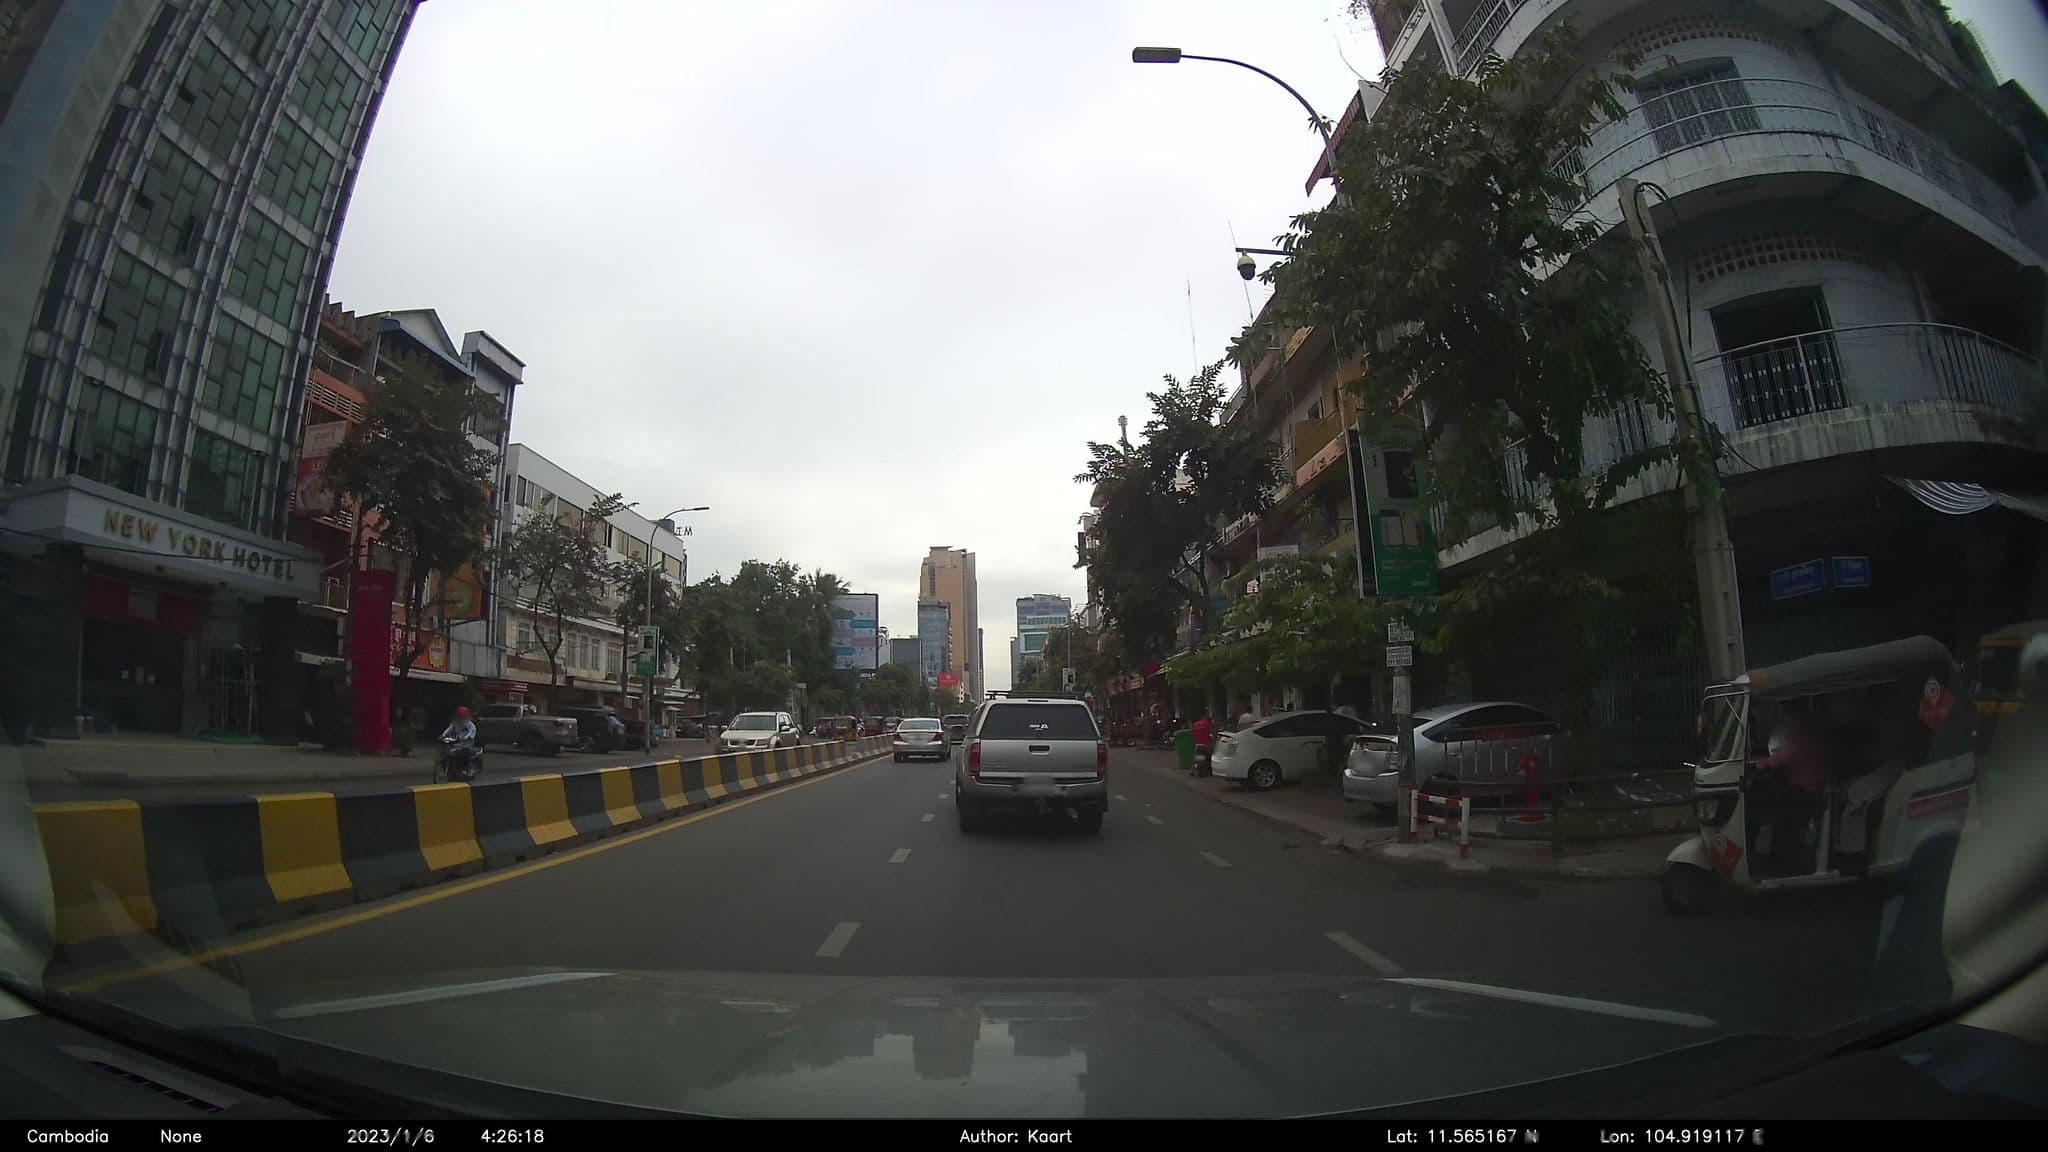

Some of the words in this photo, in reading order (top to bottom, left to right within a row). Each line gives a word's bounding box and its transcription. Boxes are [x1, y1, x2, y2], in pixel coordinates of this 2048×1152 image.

[105, 510, 157, 543] NEW
[169, 528, 225, 560] YORK
[233, 548, 294, 580] HOTEL
